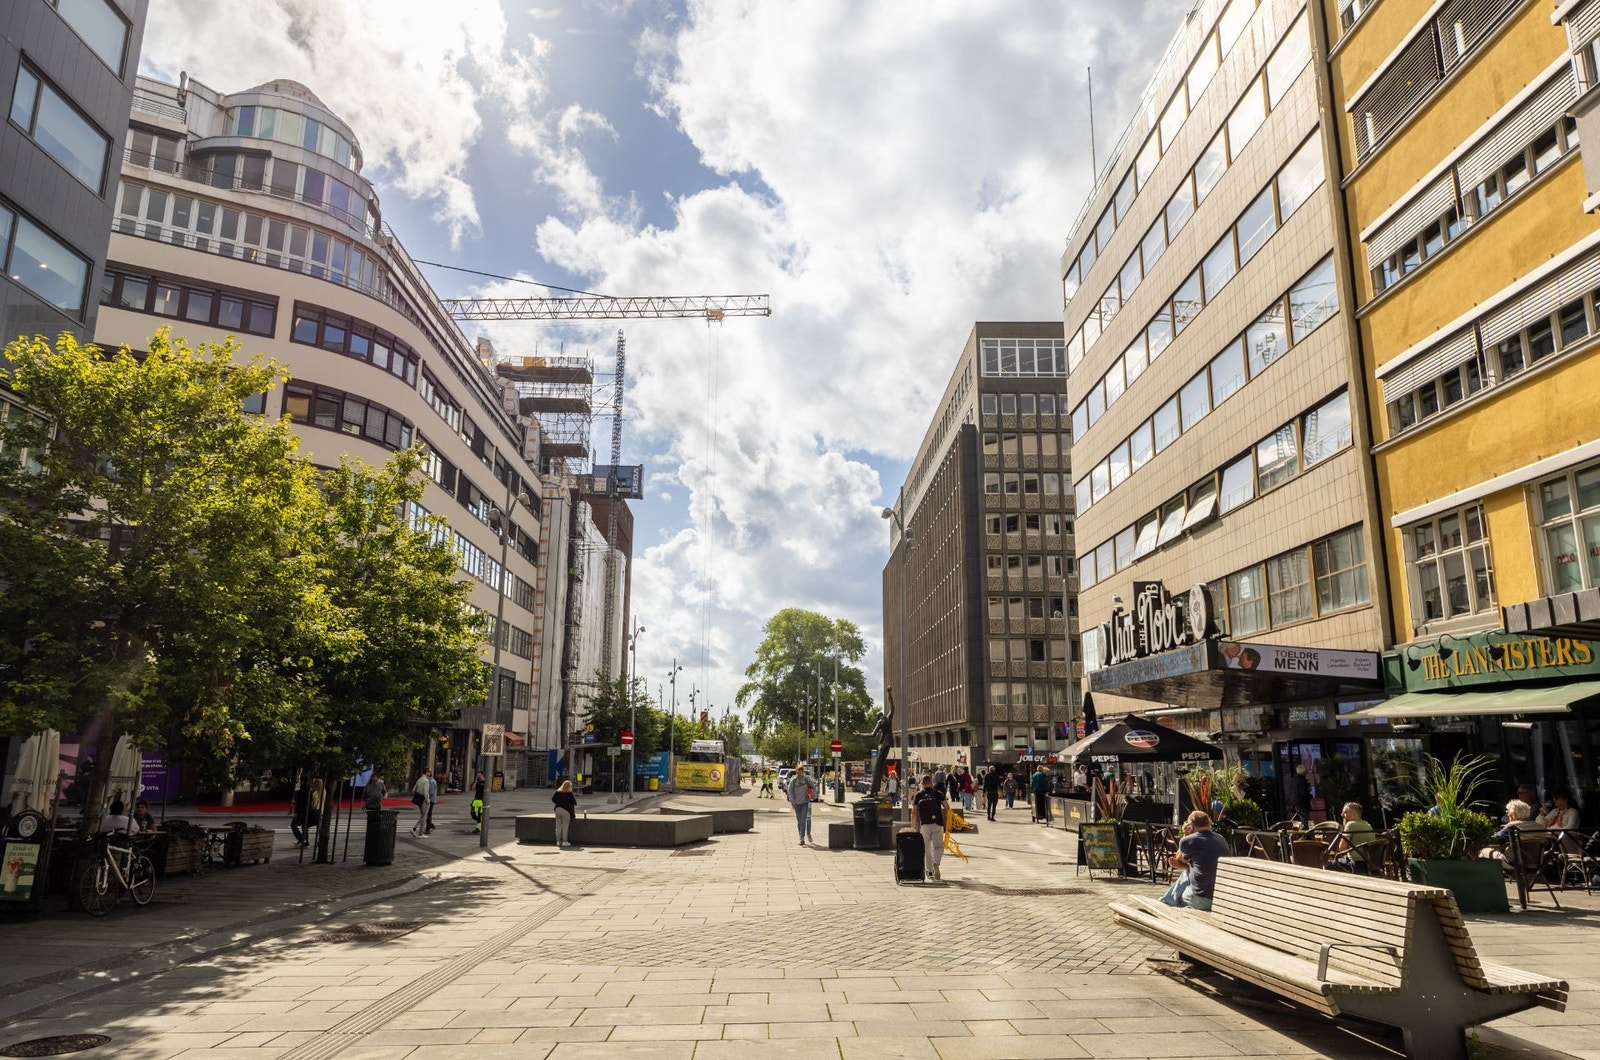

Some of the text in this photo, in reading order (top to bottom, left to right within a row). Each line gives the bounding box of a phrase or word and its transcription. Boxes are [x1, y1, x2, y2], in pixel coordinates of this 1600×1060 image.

[1110, 585, 1186, 664] Chat Noir
[1274, 657, 1319, 672] MENN
[1421, 637, 1593, 681] THE LANNISTERS
[1017, 755, 1046, 764] joer
[1182, 752, 1210, 760] PEPSI
